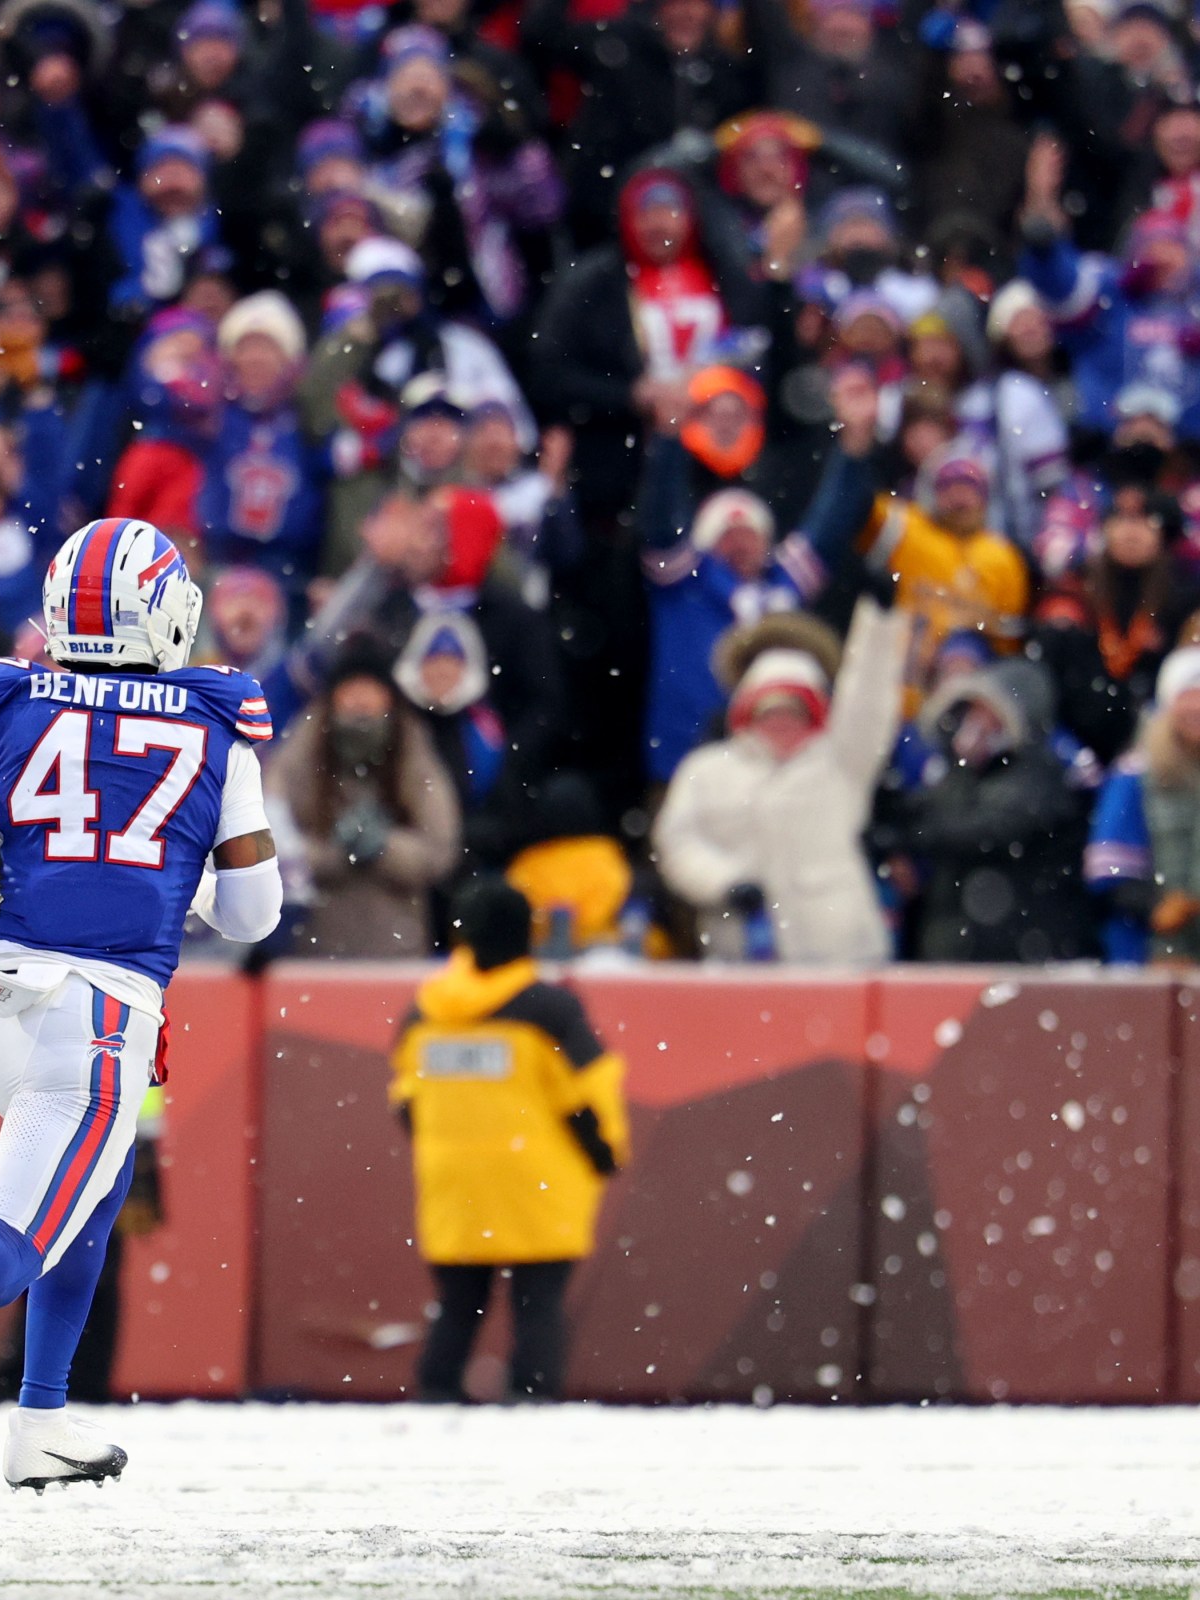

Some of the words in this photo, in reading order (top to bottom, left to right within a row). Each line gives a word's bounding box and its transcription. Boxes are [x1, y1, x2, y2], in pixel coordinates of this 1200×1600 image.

[69, 642, 114, 654] BILLS
[30, 672, 187, 714] BENFORD
[7, 709, 208, 869] 47
